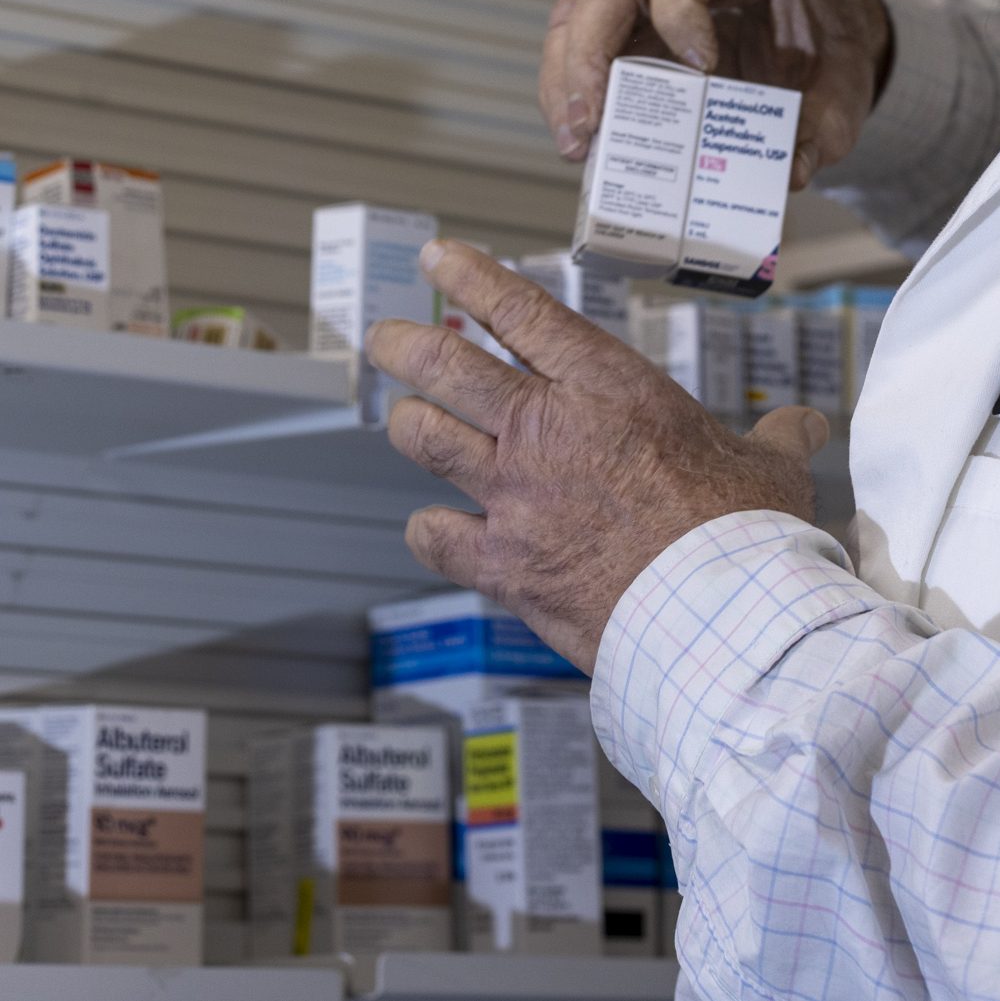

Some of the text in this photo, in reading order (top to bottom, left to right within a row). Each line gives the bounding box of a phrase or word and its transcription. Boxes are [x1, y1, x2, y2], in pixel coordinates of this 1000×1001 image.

[705, 110, 746, 125] Acetate
[707, 97, 785, 119] prednisoLONE
[703, 123, 766, 144] Ophthalmic
[702, 137, 788, 161] Suspension, USP
[96, 726, 190, 755] Albuterol
[95, 752, 168, 782] Sulfate
[340, 744, 430, 768] Albuterol
[340, 769, 411, 794] Sulfate
